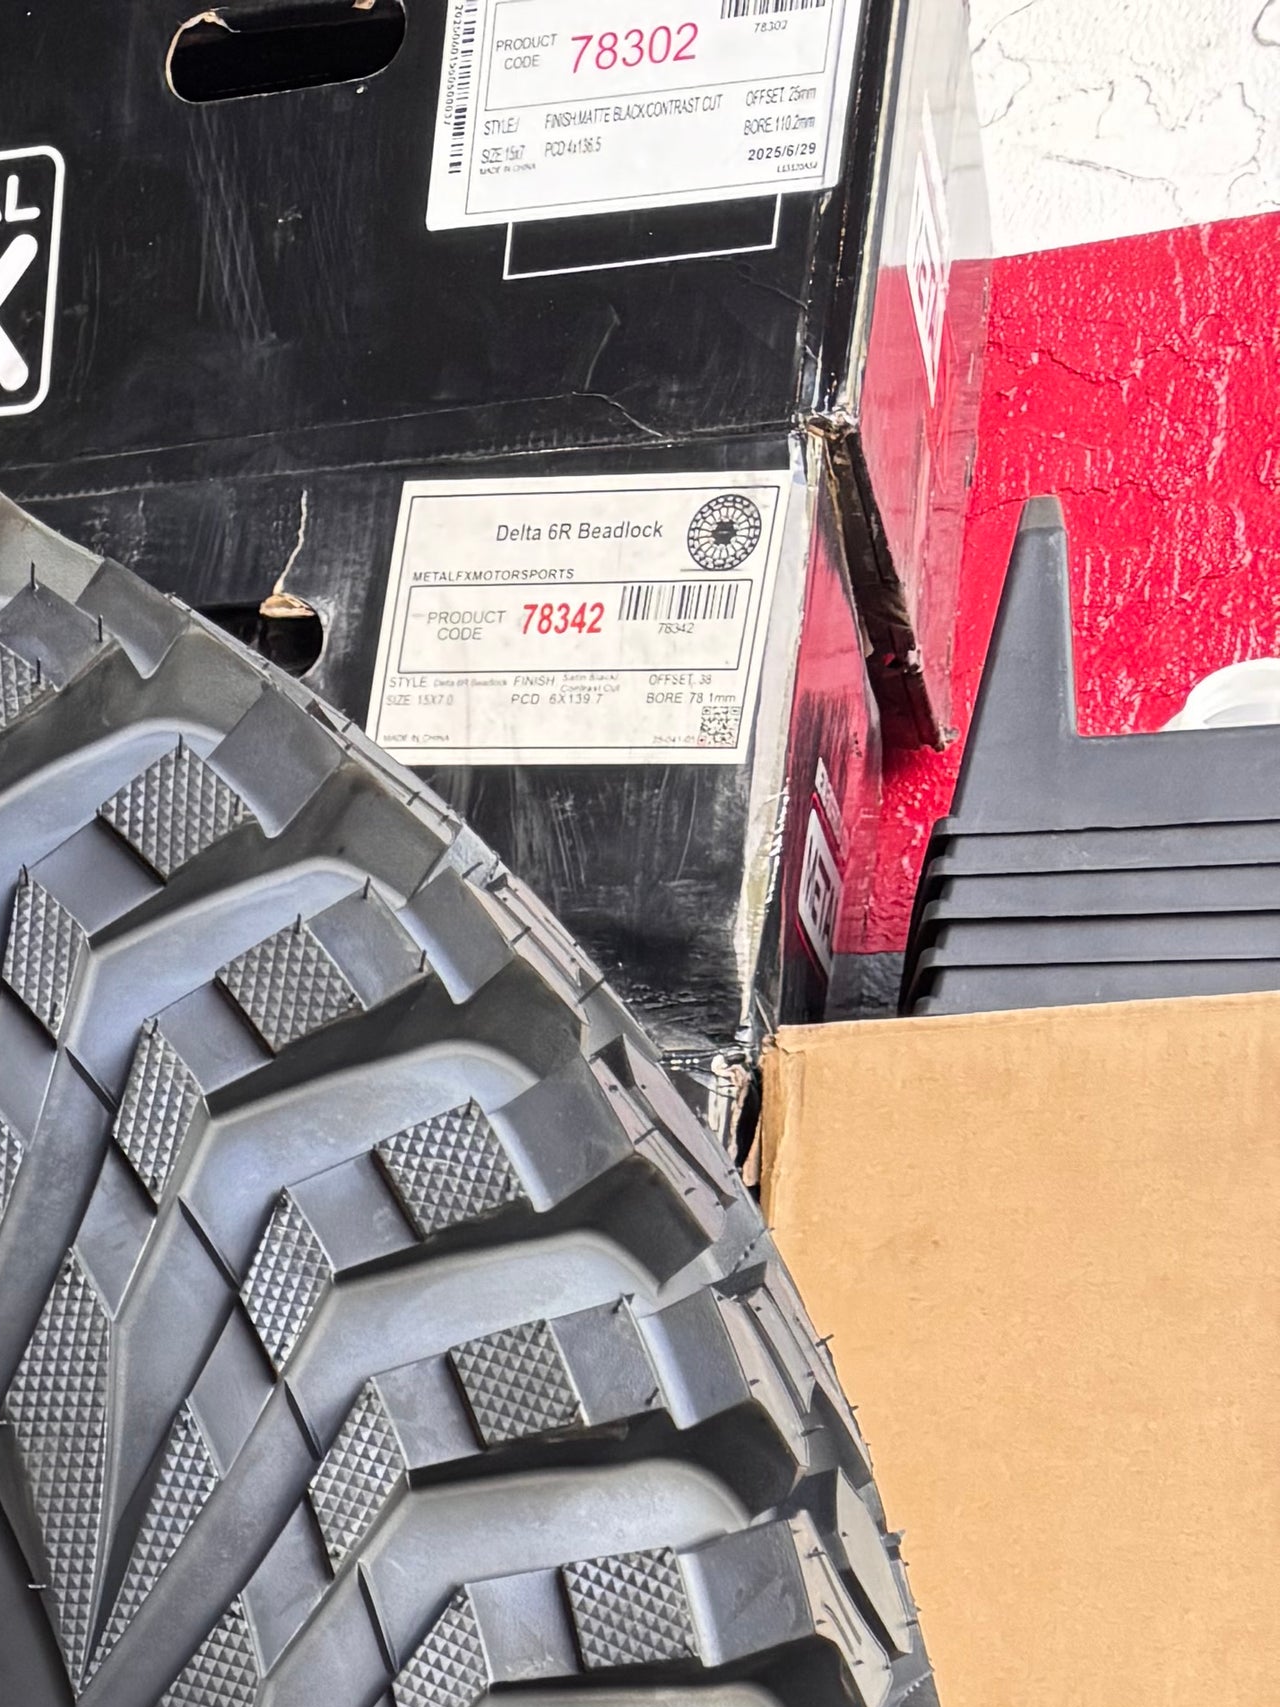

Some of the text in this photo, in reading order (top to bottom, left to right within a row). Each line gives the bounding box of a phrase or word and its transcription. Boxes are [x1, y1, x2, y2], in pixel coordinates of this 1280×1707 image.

[495, 33, 558, 52] PRODUCT
[570, 22, 699, 74] 78302
[504, 55, 540, 70] CODE
[748, 142, 817, 161] 2025/6/29
[496, 521, 663, 542] Delta 6R Beadlock
[412, 568, 575, 583] METALFXMOTORSPORTS
[427, 610, 507, 625] PRODUCT
[521, 602, 605, 635] 78342
[437, 627, 483, 641] CODE
